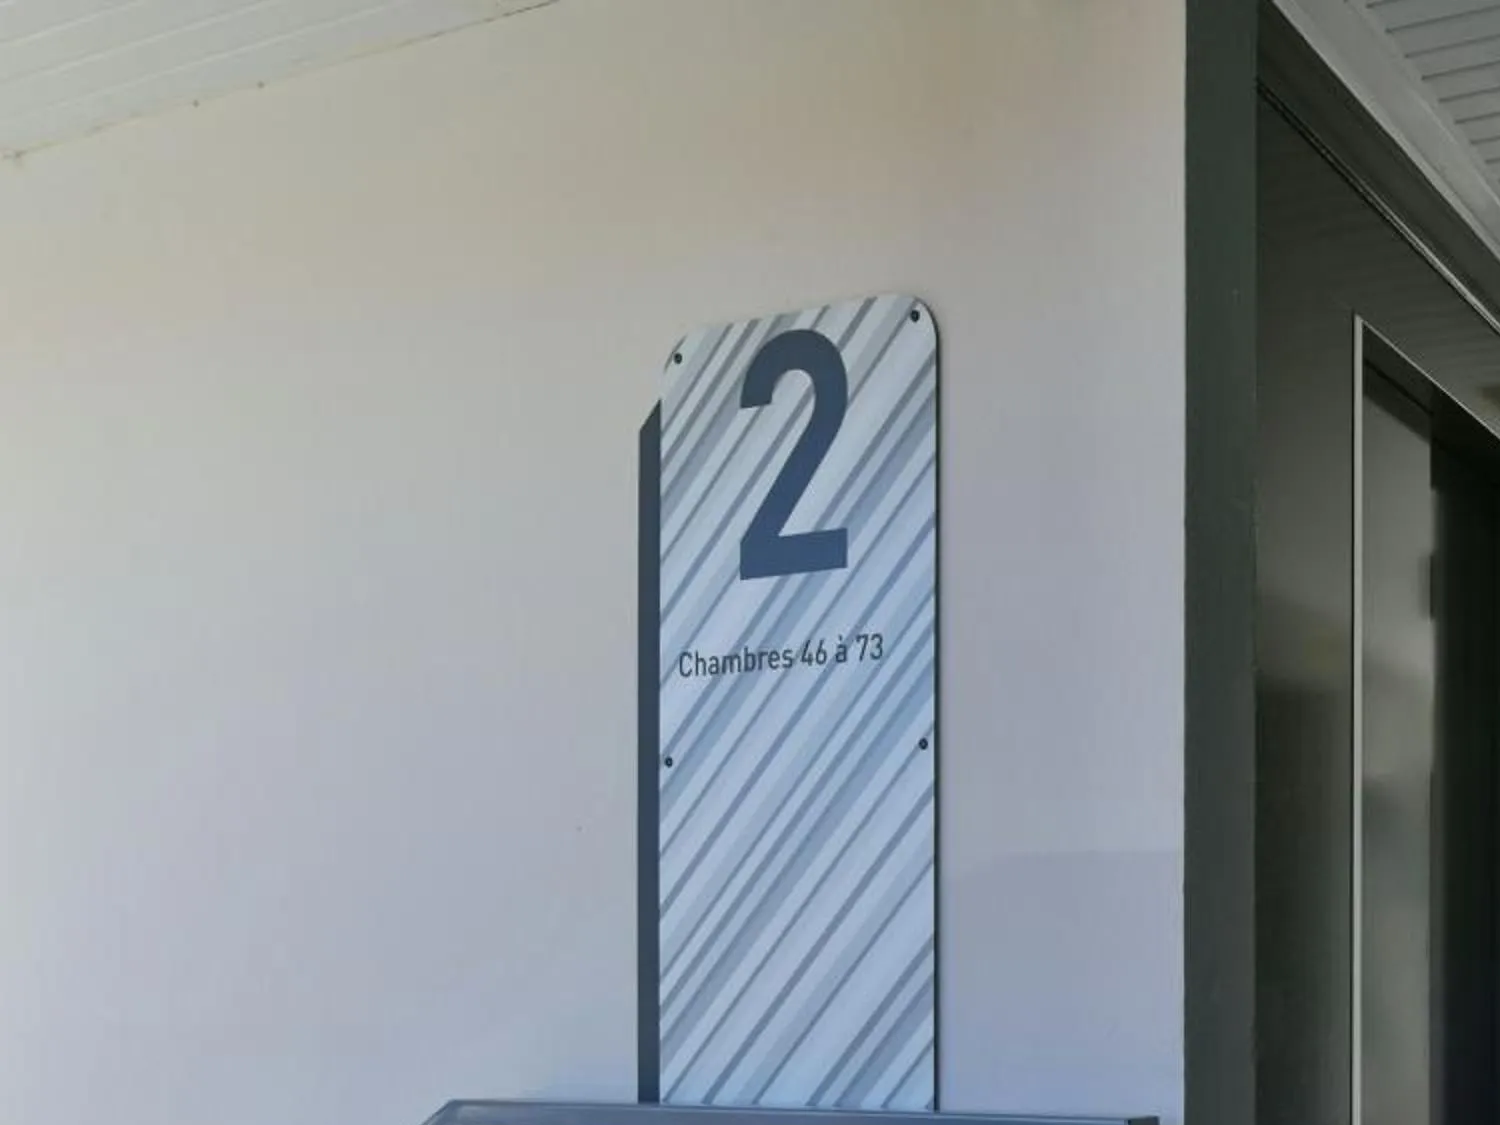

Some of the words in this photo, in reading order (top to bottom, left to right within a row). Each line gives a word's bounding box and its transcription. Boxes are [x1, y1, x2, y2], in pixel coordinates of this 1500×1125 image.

[740, 329, 848, 580] 2
[679, 647, 794, 677] Chambres
[801, 639, 827, 666] 46
[835, 635, 848, 663] à
[856, 633, 884, 662] 73
